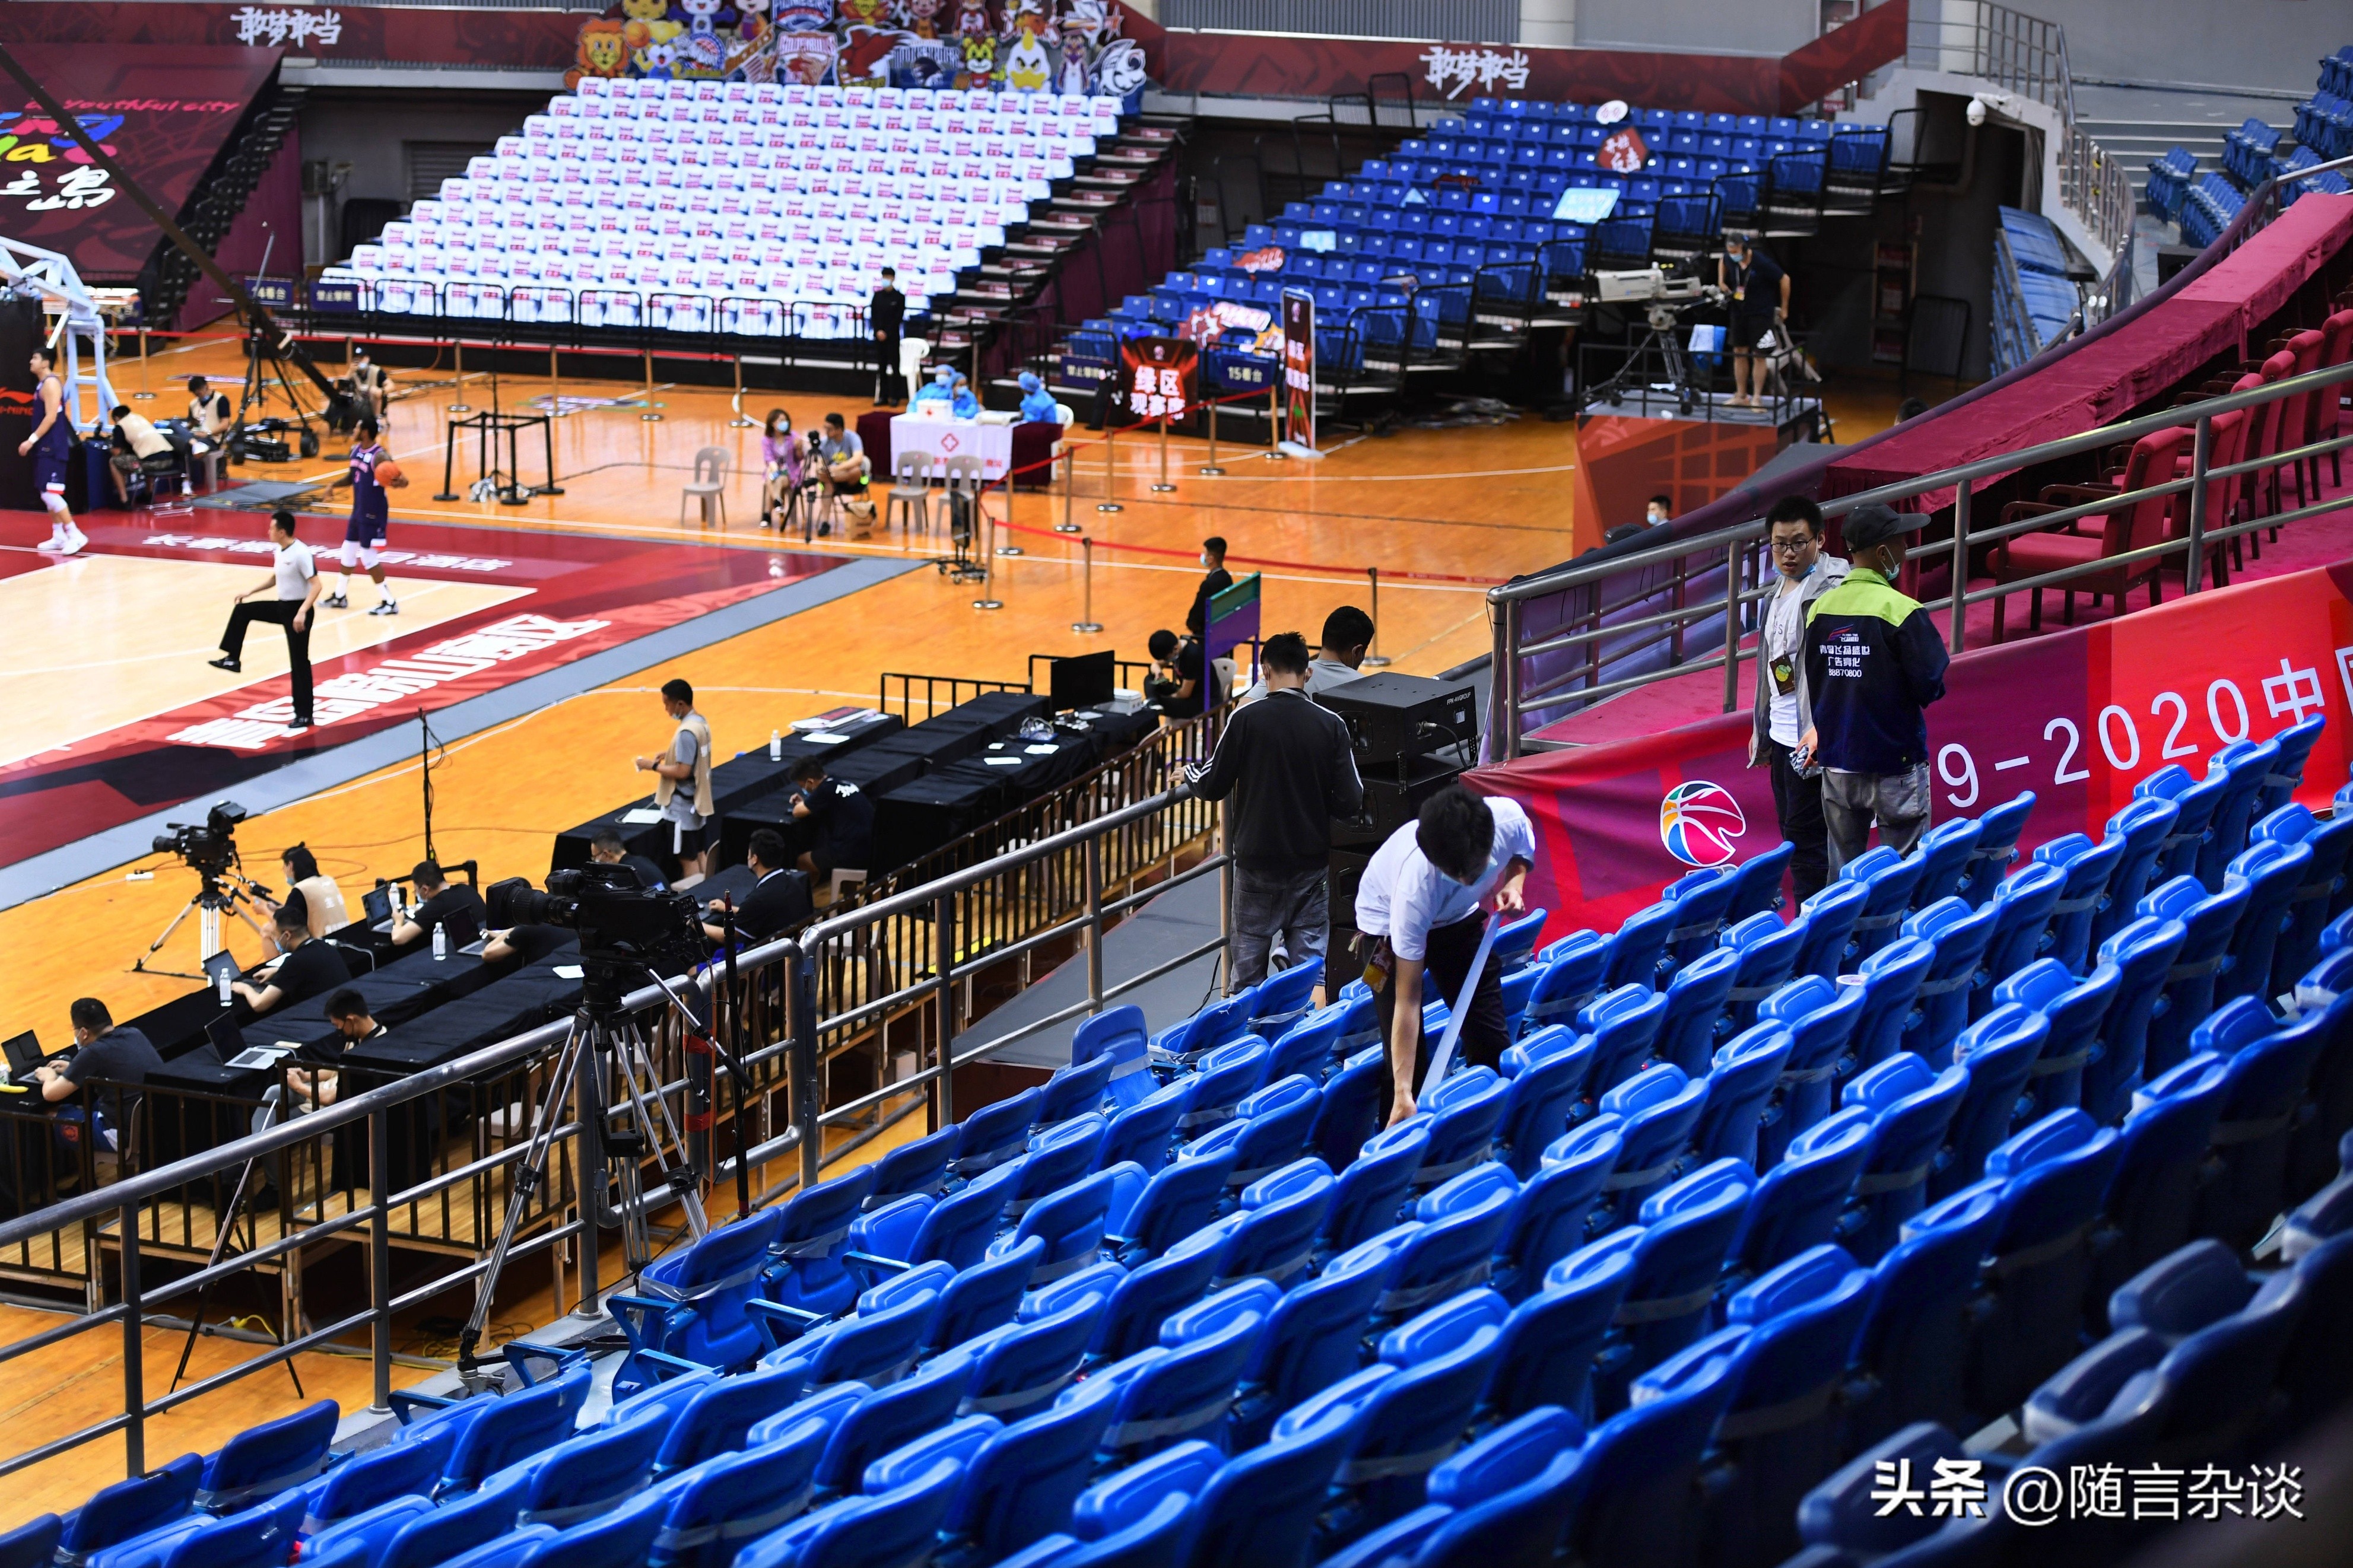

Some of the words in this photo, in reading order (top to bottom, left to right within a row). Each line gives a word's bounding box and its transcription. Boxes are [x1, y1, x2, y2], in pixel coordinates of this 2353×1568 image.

[1228, 366, 1263, 383] 15看台
[1134, 365, 1180, 396] 绿区
[1819, 645, 1870, 655] 青岛飞扬盛世
[1828, 656, 1860, 667] 广告亮化
[1828, 669, 1862, 678] 88870800
